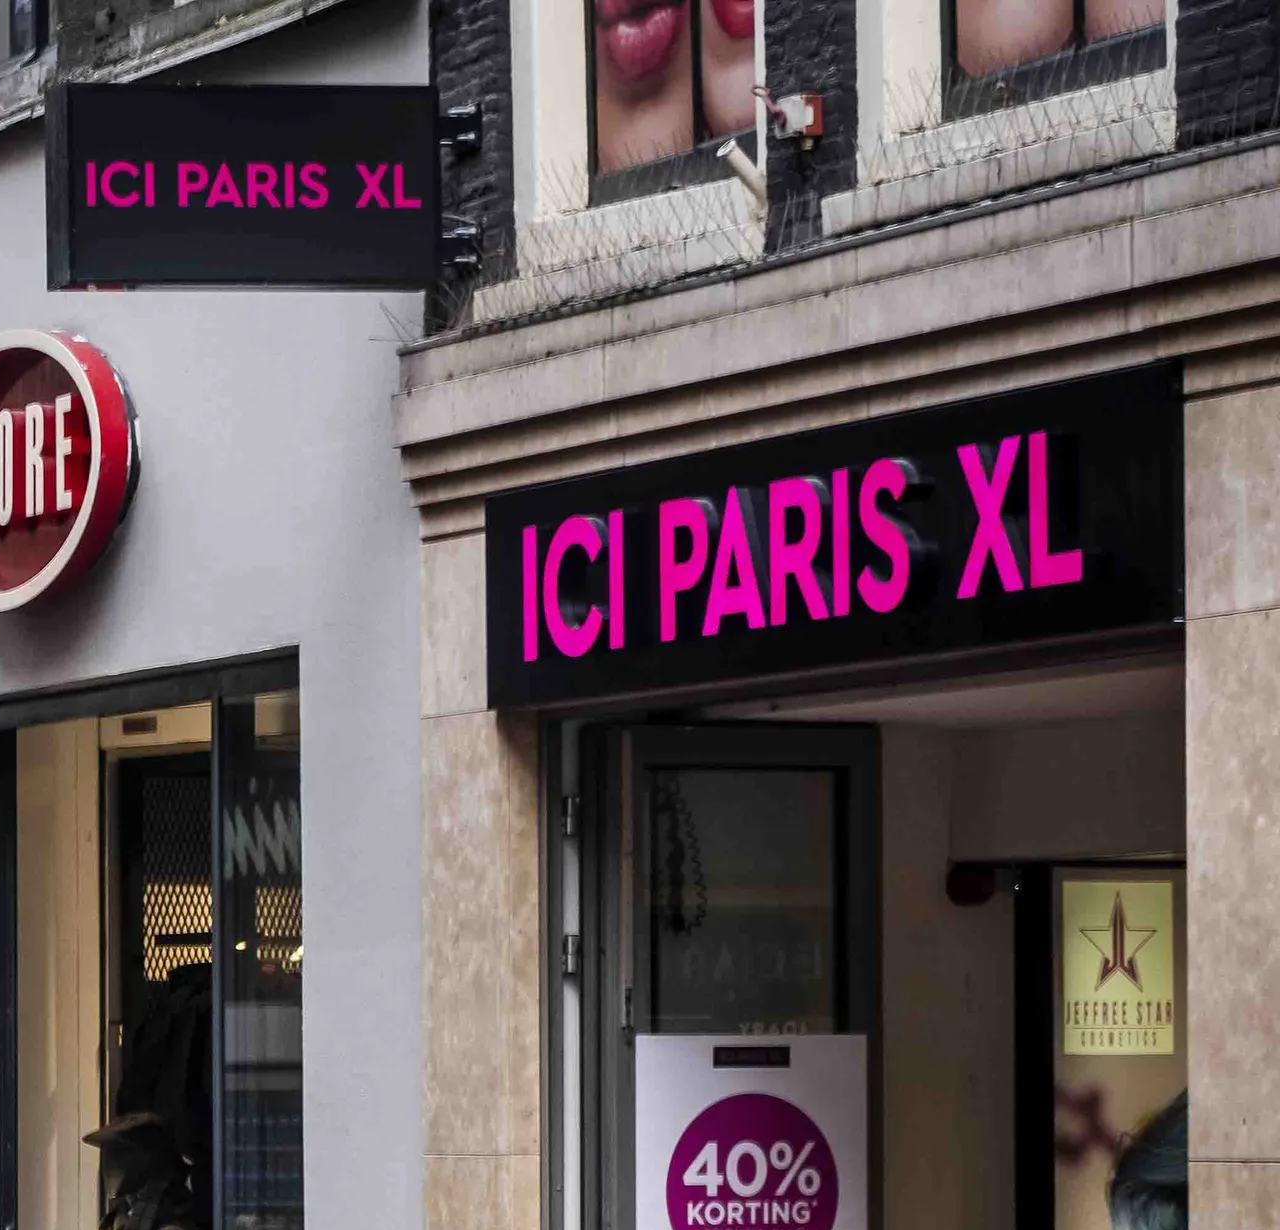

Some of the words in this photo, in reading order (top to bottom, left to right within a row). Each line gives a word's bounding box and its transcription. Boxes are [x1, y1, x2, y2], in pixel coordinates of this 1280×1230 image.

[85, 160, 155, 209] ICI
[176, 160, 329, 210] PARIS
[355, 161, 422, 209] XL
[522, 508, 624, 662] ICI
[659, 456, 912, 643] PARIS
[956, 431, 1084, 599] XL
[1065, 1000, 1128, 1026] JEFFREE
[1136, 1000, 1172, 1026] STAR
[682, 1140, 822, 1198] 40%
